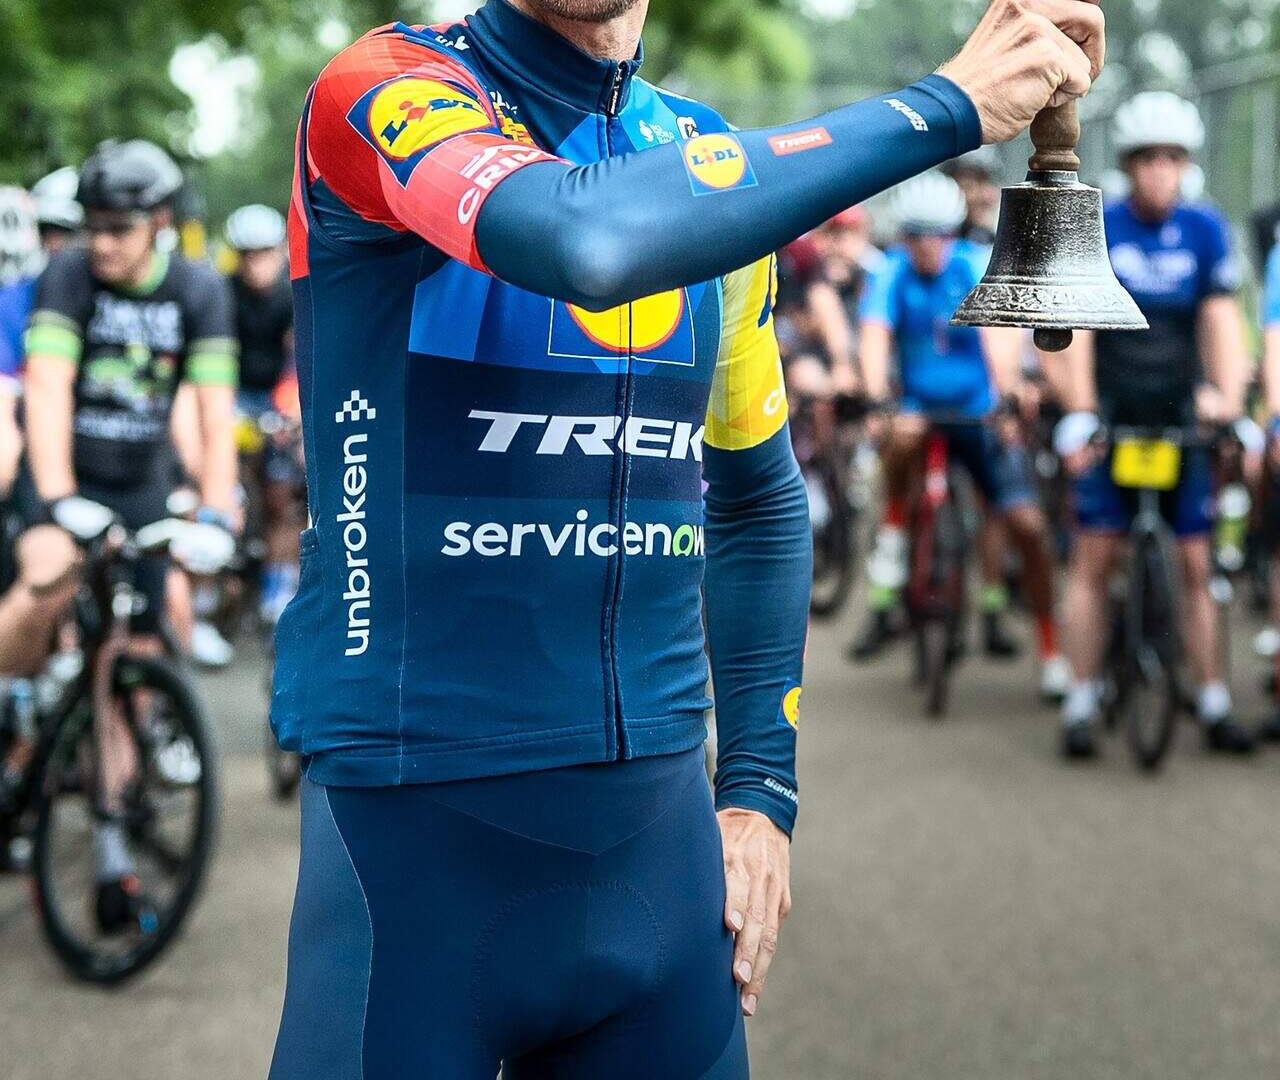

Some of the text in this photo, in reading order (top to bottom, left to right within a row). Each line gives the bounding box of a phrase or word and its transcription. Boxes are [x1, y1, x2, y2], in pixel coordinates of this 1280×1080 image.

[775, 132, 823, 150] TREK
[468, 409, 705, 462] TREK
[336, 433, 371, 656] unbroken
